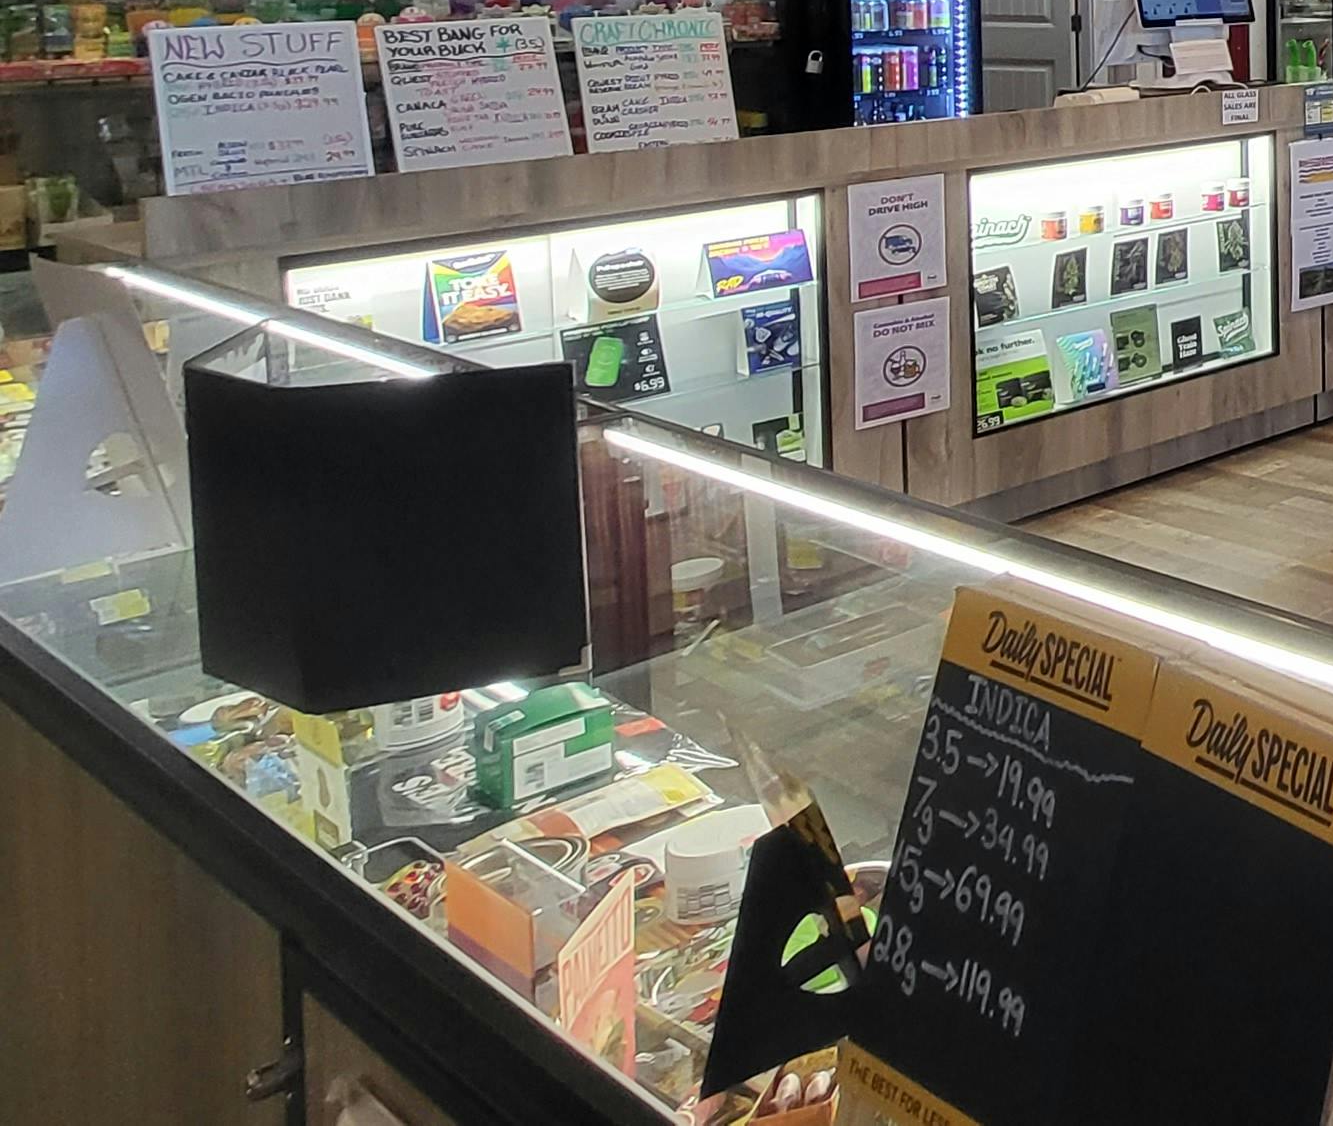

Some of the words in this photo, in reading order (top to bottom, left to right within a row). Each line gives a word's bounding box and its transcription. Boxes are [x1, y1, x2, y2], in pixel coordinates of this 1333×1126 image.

[383, 29, 434, 45] BEST
[437, 26, 487, 42] BANG
[490, 23, 524, 38] FOR
[580, 20, 635, 45] CRAFT
[638, 19, 717, 42] CHRONIC
[164, 33, 225, 61] NEW
[239, 31, 344, 58] STUFF
[385, 46, 438, 59] YOUR
[439, 41, 488, 57] BUCK
[1223, 92, 1235, 100] ALL
[1236, 90, 1257, 99] GLASS
[396, 99, 448, 114] CANACA
[1223, 102, 1243, 111] SALES
[1244, 101, 1257, 110] ARE
[1230, 113, 1251, 122] FINAL
[868, 204, 900, 216] DRIVE
[902, 200, 929, 211] HIGH
[880, 193, 914, 205] DON'T
[448, 275, 500, 292] TOKE
[716, 276, 745, 292] RAD
[441, 291, 460, 306] IT
[461, 282, 513, 302] EASY
[872, 328, 890, 338] DO
[891, 325, 914, 336] NOT
[915, 319, 935, 330] MIX
[986, 345, 999, 354] no
[1000, 337, 1036, 352] further.
[634, 377, 666, 392] $6.99
[981, 610, 1043, 682] Daily
[1040, 631, 1115, 702] SPECIAL
[963, 674, 1051, 752] INDICA
[1185, 698, 1256, 785] Daily
[921, 714, 963, 775] 3.5
[998, 754, 1056, 828] 19.99
[912, 775, 938, 845] 7g
[980, 807, 1049, 881] 34.99
[955, 865, 1025, 947] 69.99
[874, 914, 917, 997] 28g
[959, 958, 1026, 1038] 119.99
[849, 1057, 872, 1086] THE
[871, 1072, 900, 1106] BEST
[900, 1090, 923, 1120] FOR
